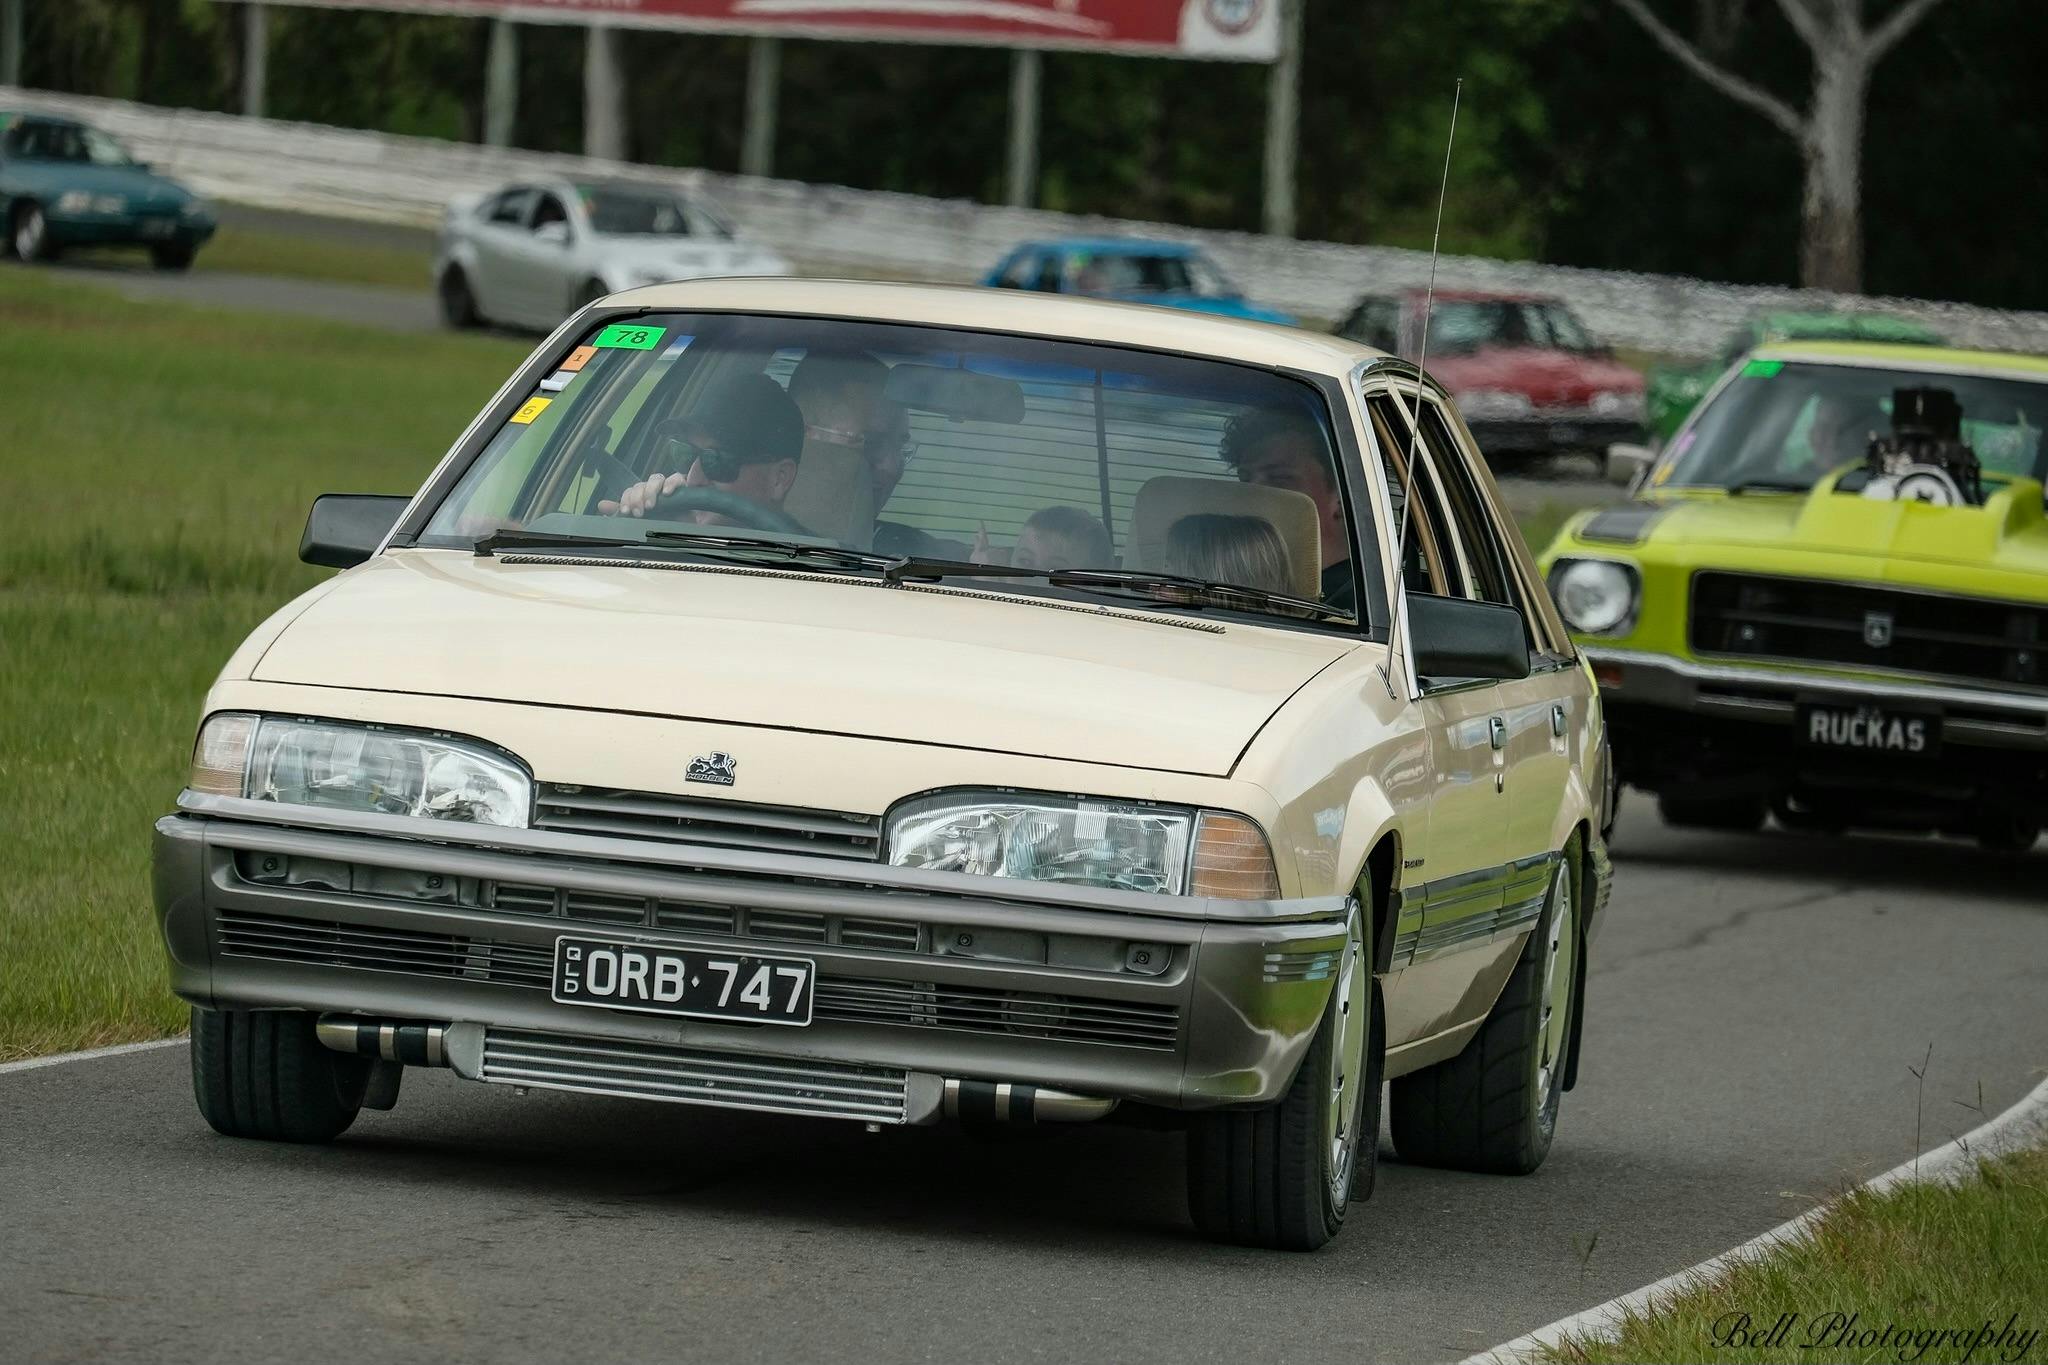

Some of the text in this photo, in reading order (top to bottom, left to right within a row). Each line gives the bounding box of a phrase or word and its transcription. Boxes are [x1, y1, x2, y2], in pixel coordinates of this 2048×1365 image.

[616, 331, 649, 344] 78
[1811, 711, 1925, 752] RUCKAS
[687, 773, 733, 784] HOLDEN
[564, 946, 581, 994] QLD
[586, 950, 808, 1014] ORB 747
